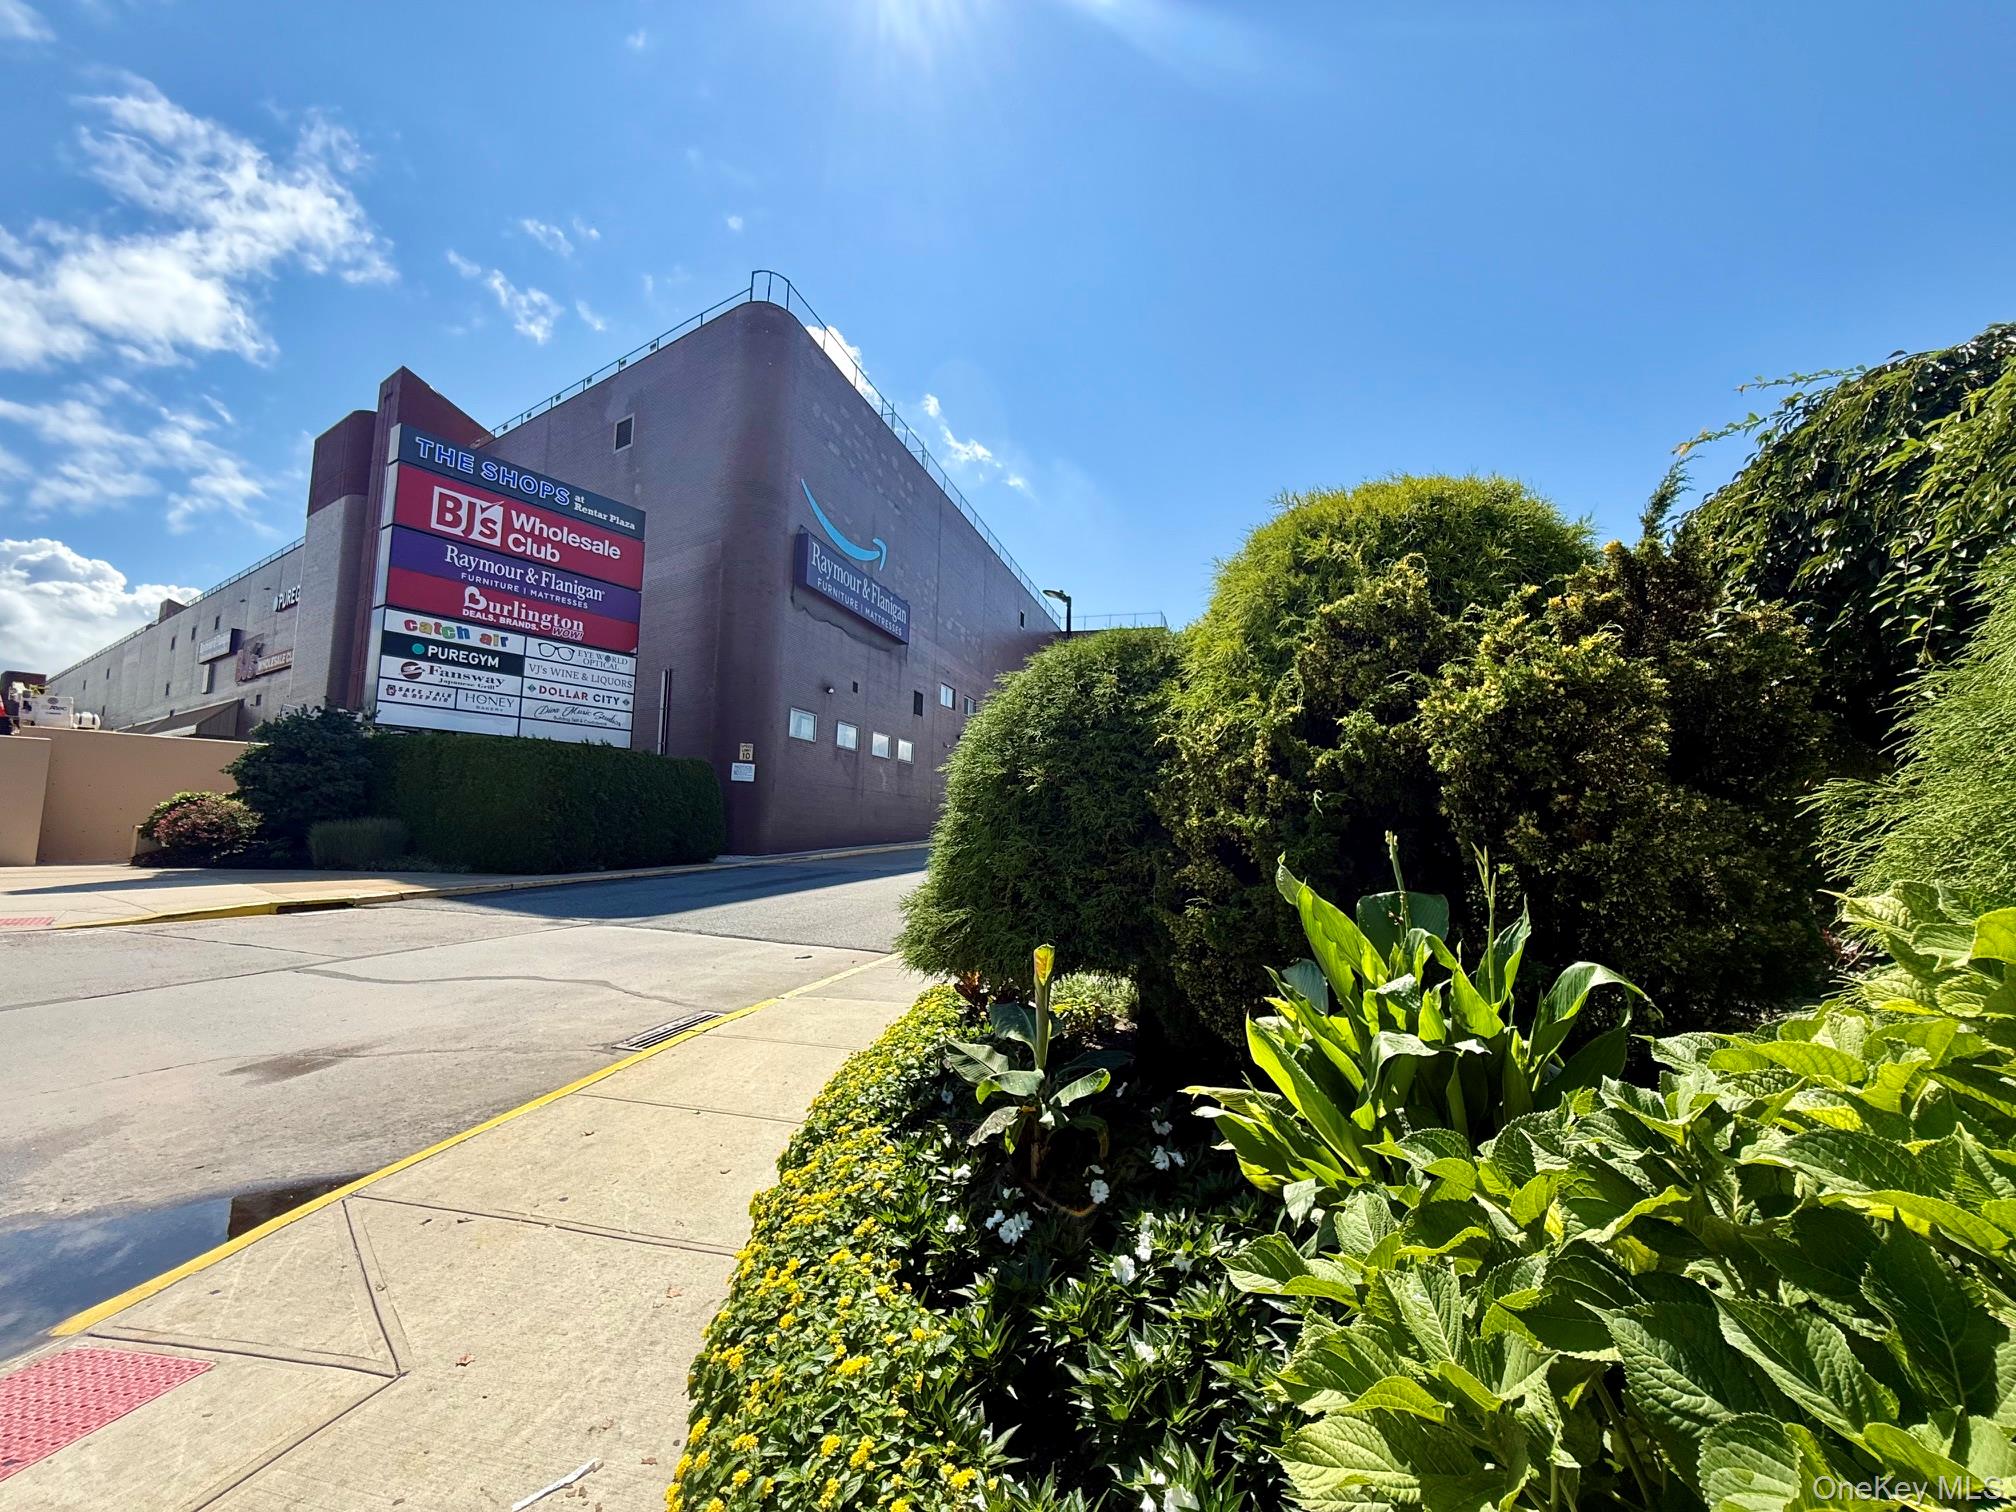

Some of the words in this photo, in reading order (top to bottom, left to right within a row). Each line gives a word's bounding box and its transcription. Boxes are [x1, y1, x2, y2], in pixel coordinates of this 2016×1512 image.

[416, 436, 475, 474] THE
[481, 461, 570, 506] SHOPS
[574, 494, 585, 504] at
[574, 502, 608, 522] Rentar
[609, 515, 636, 530] Plaza
[507, 533, 561, 563] Club
[510, 509, 621, 560] Wholesale
[444, 544, 524, 581] Raymour
[525, 567, 539, 585] &
[461, 572, 520, 593] FURNITURE
[530, 589, 588, 609] MATTRESSES
[811, 541, 861, 594] Raymour
[862, 577, 871, 601] &
[871, 582, 907, 625] Flanigan
[464, 585, 584, 632] Burlington
[817, 577, 859, 610] FURNITURE
[865, 607, 902, 636] MATTRESSES
[404, 619, 471, 640] catch
[480, 633, 509, 648] air
[462, 608, 497, 623] DEALS.
[499, 616, 540, 632] BRANDS.
[552, 626, 584, 641] WOW!
[428, 645, 500, 668] PUREGYM
[578, 649, 594, 660] EYE
[582, 659, 620, 671] OPTICAL
[428, 664, 506, 688] Fansway
[529, 663, 548, 674] VJ's
[550, 667, 580, 680] WINE
[581, 673, 589, 681] &
[591, 674, 633, 688] LIQUORS
[465, 692, 515, 708] HONEY
[538, 685, 589, 701] DOLLAR
[593, 693, 620, 706] CITY
[561, 705, 592, 717] Music
